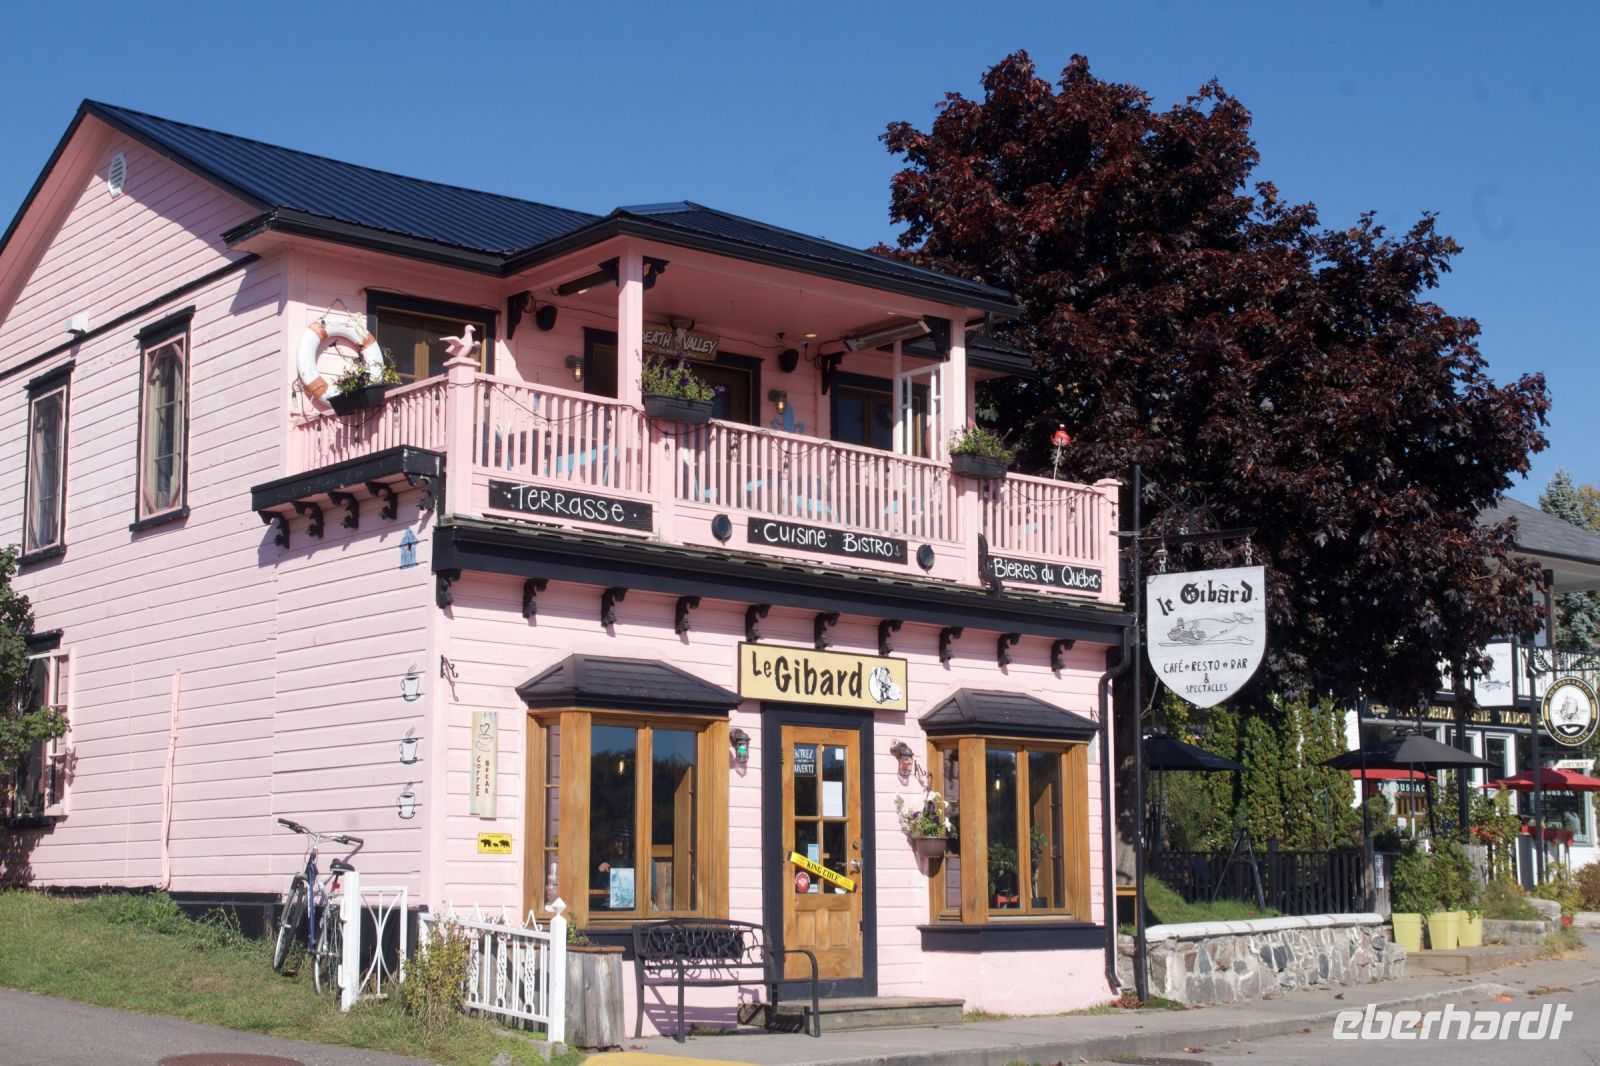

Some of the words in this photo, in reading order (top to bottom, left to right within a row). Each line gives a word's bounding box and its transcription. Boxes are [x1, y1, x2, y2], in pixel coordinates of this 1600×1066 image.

[683, 336, 717, 354] VALLEY
[1041, 564, 1054, 583] du
[1191, 659, 1220, 672] RESTO
[1230, 658, 1248, 670] BAR
[752, 650, 772, 678] Le
[775, 656, 863, 699] Gibard
[1203, 673, 1210, 684] &
[1186, 683, 1228, 694] SPECTACLES
